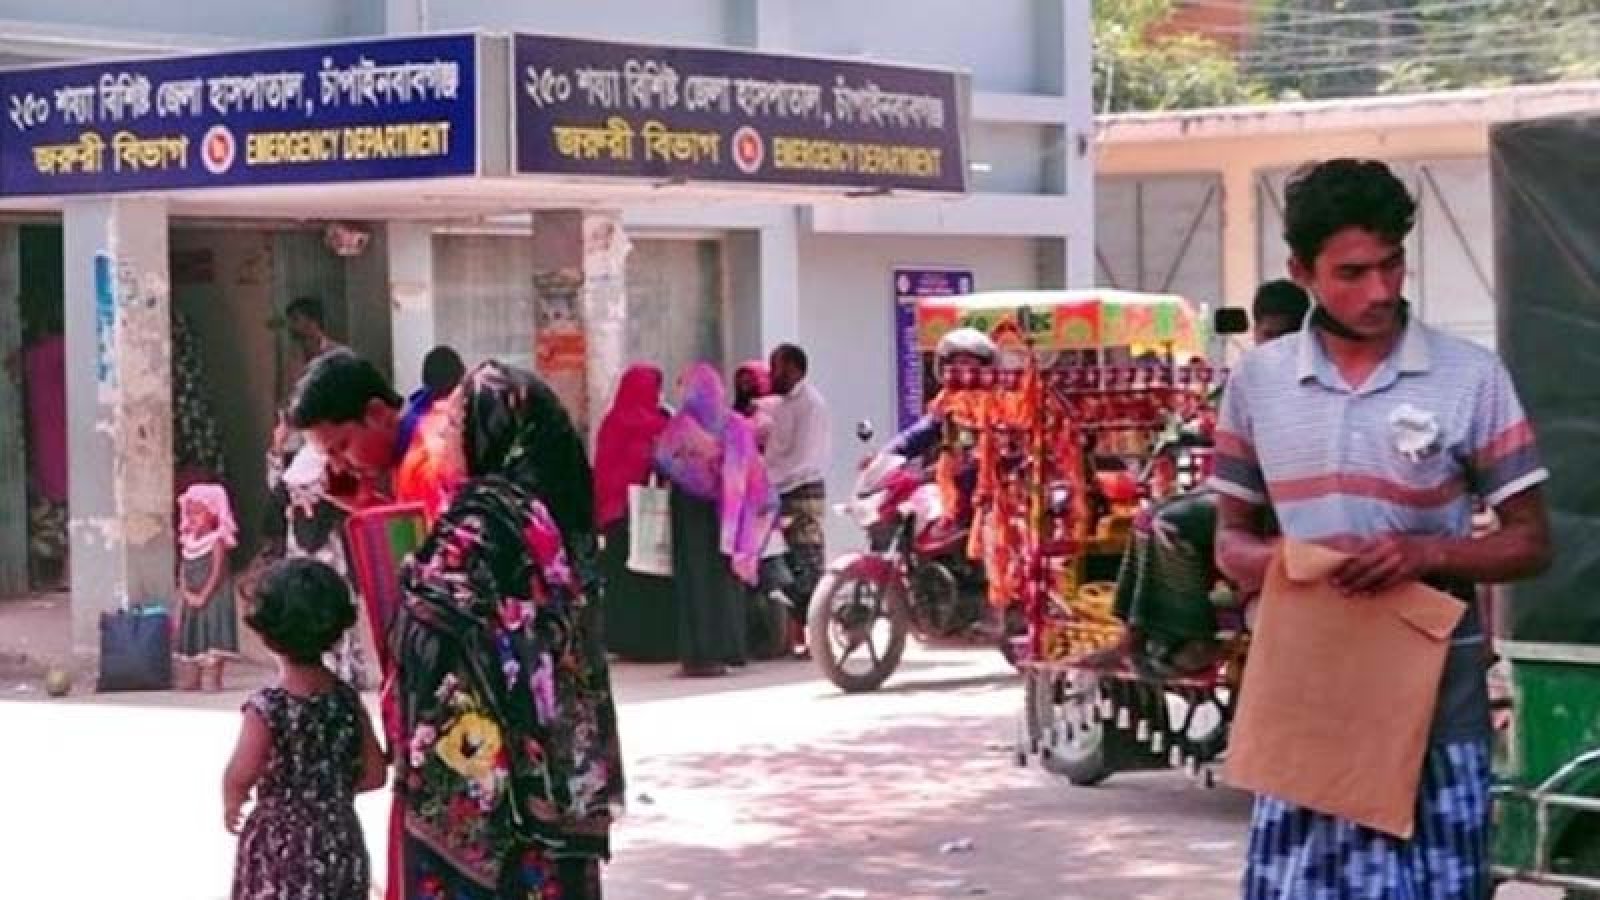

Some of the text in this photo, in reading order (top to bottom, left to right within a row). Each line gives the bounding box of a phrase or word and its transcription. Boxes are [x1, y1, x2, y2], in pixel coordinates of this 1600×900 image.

[9, 95, 50, 130] ২৫০
[156, 79, 202, 118] জেলা
[525, 65, 571, 107] ২৫০
[683, 75, 730, 114] জেলা
[112, 130, 190, 171] বিভাগ
[246, 121, 451, 165] EMERGENCY DEPARTMENT
[640, 120, 722, 164] বিভাগ
[772, 136, 942, 177] EMERGENCY DEPARTMENT
